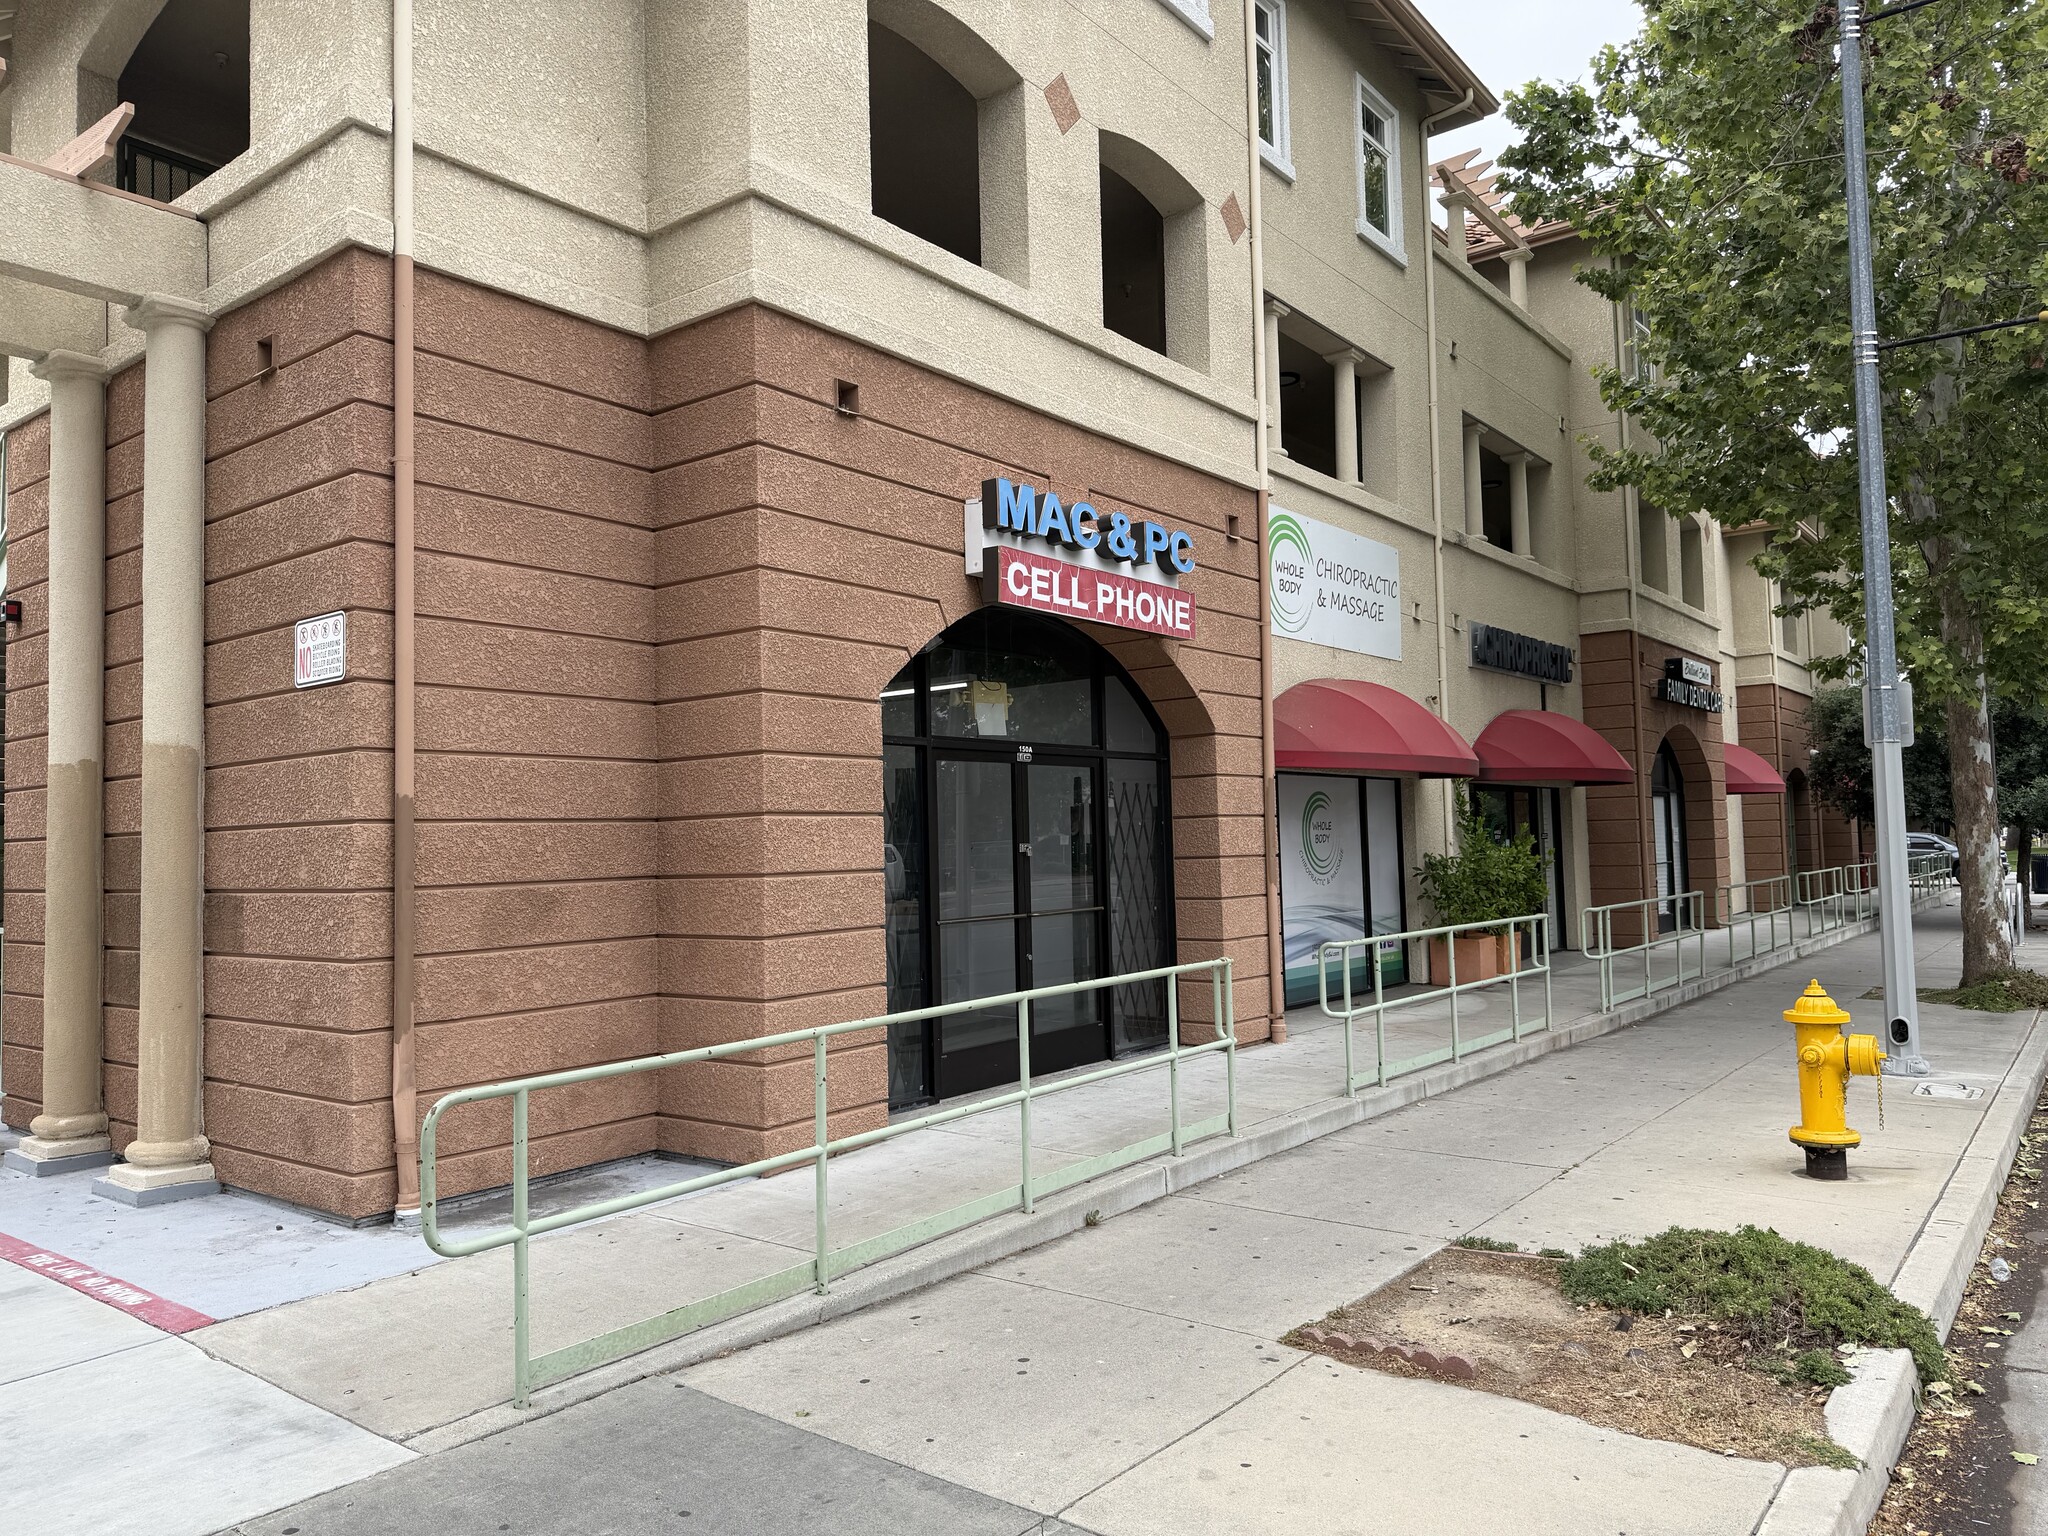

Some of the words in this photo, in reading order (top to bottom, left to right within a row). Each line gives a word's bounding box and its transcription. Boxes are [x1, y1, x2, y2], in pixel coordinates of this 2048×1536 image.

[996, 478, 1101, 550] MAC
[1108, 511, 1139, 560] &
[1144, 521, 1196, 573] PC
[1275, 559, 1304, 579] WHOLE
[1316, 558, 1398, 599] CHIROPRACTIC
[1007, 561, 1089, 610] CELL
[1097, 583, 1191, 631] PHONE
[1279, 578, 1302, 595] BODY
[1316, 588, 1326, 608] &
[1330, 591, 1385, 622] MASSAGE
[299, 646, 312, 680] NO
[1477, 624, 1573, 684] CHIROPRACTIC
[1667, 678, 1689, 704] FAMILY
[1689, 685, 1710, 710] DENTAL
[1018, 745, 1033, 753] 150A
[1312, 821, 1332, 831] WHOLE
[1315, 833, 1330, 844] BODY
